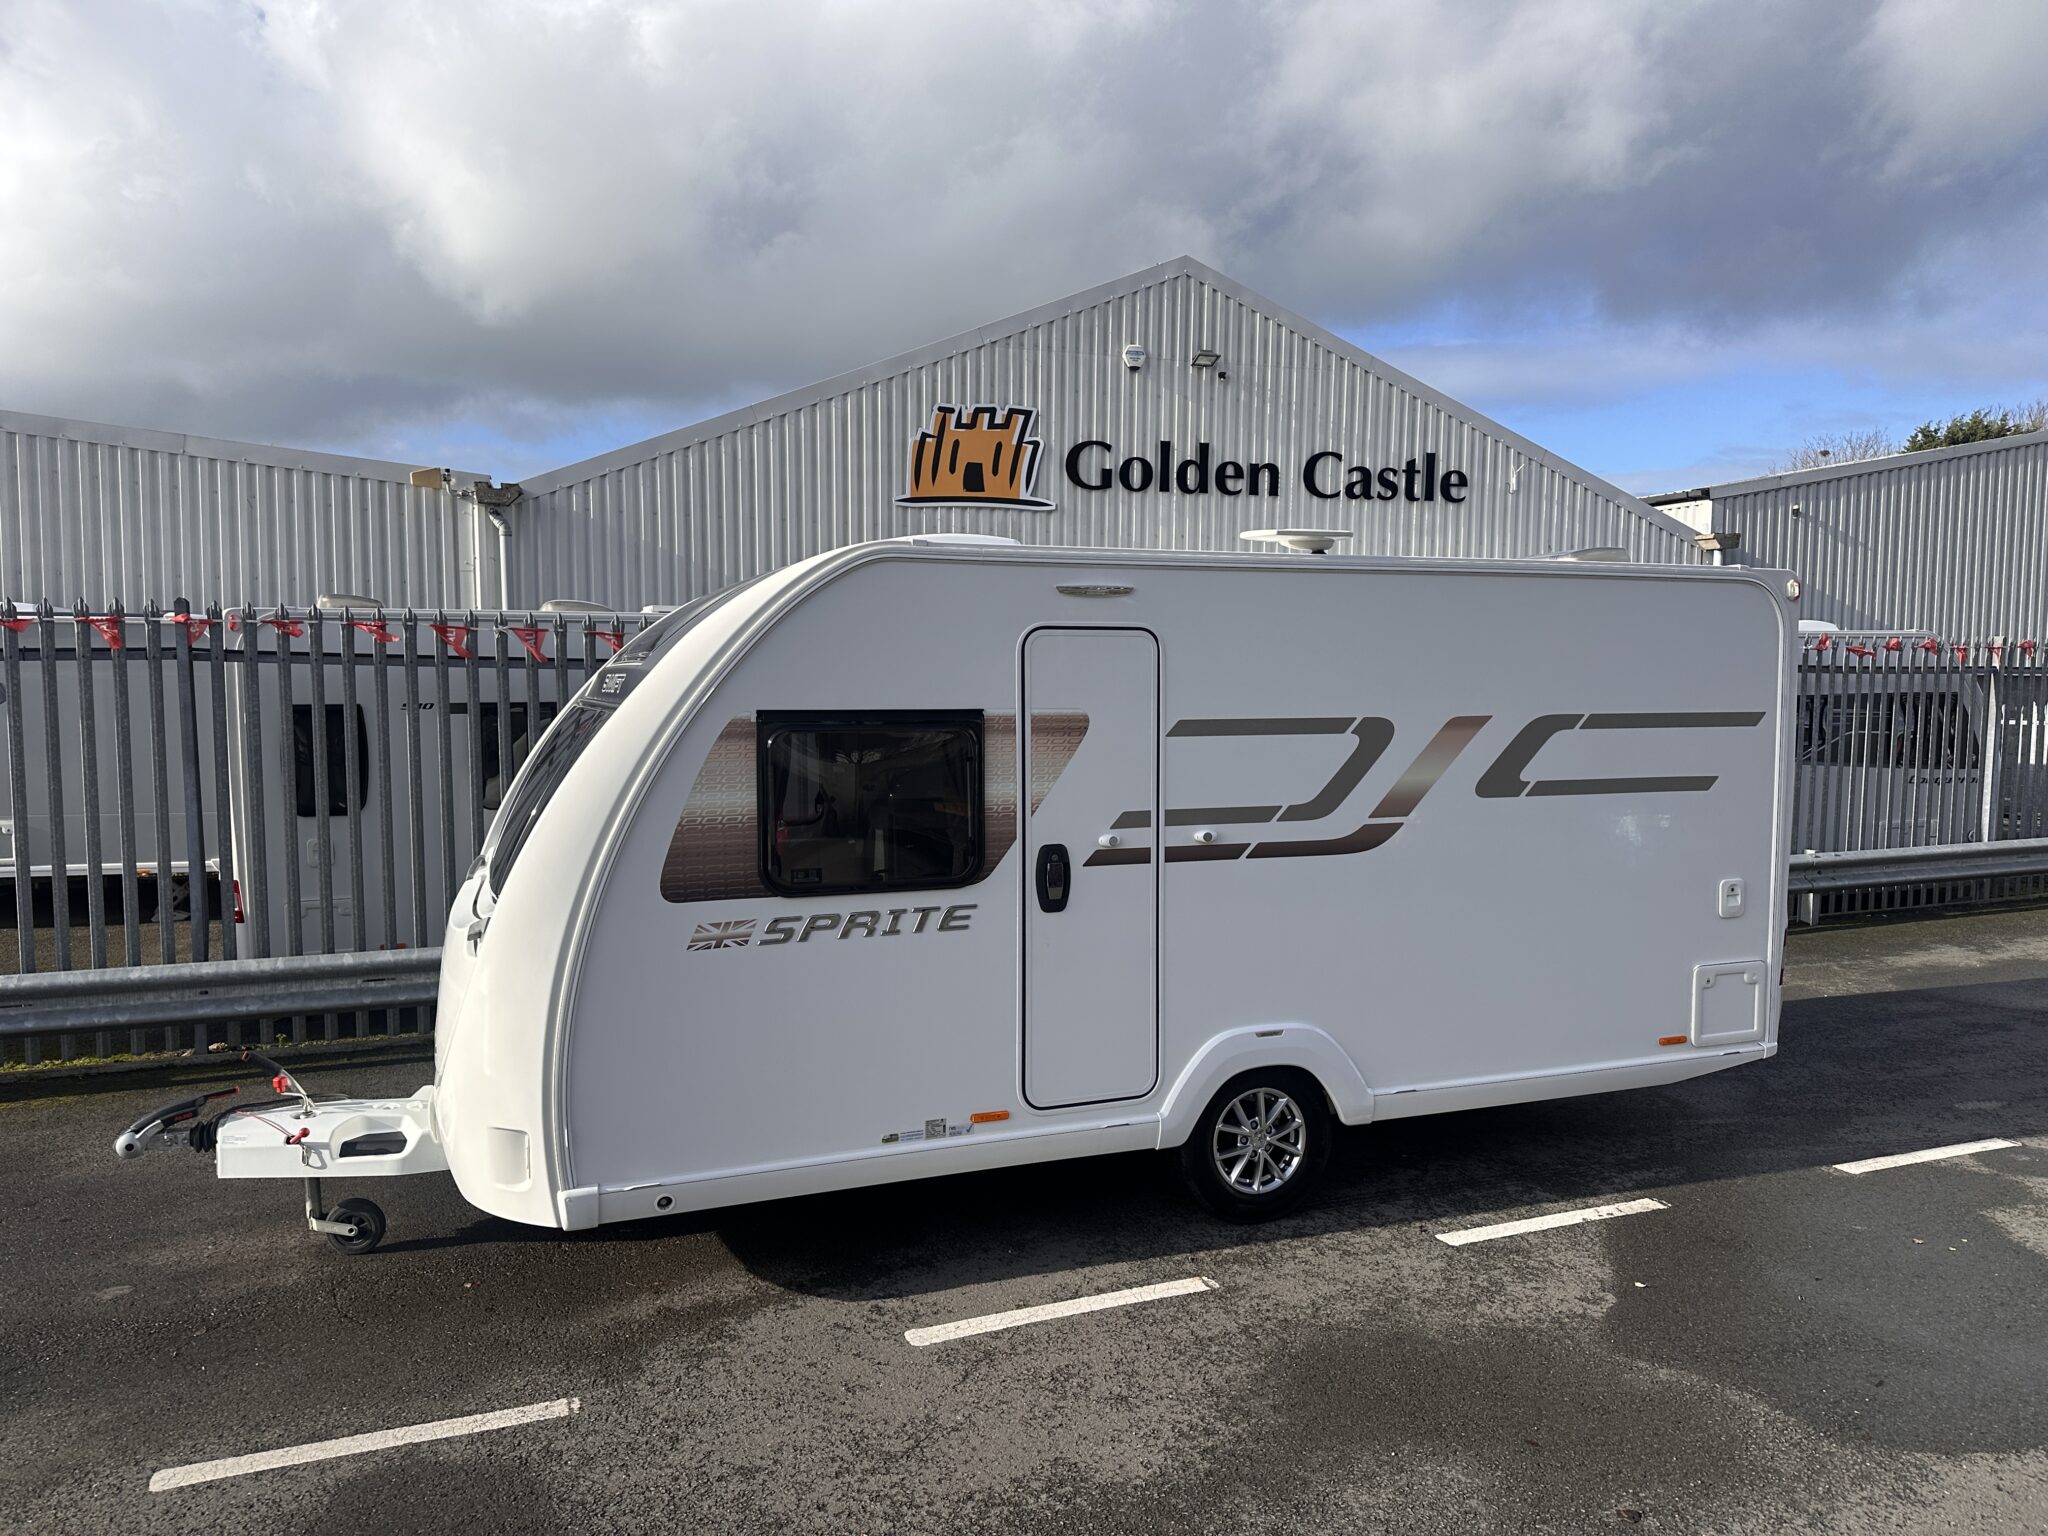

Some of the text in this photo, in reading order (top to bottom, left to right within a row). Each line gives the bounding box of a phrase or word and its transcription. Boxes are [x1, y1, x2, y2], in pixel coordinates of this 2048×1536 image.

[1065, 440, 1469, 504] Golden Castle
[756, 903, 978, 947] SPRITE
